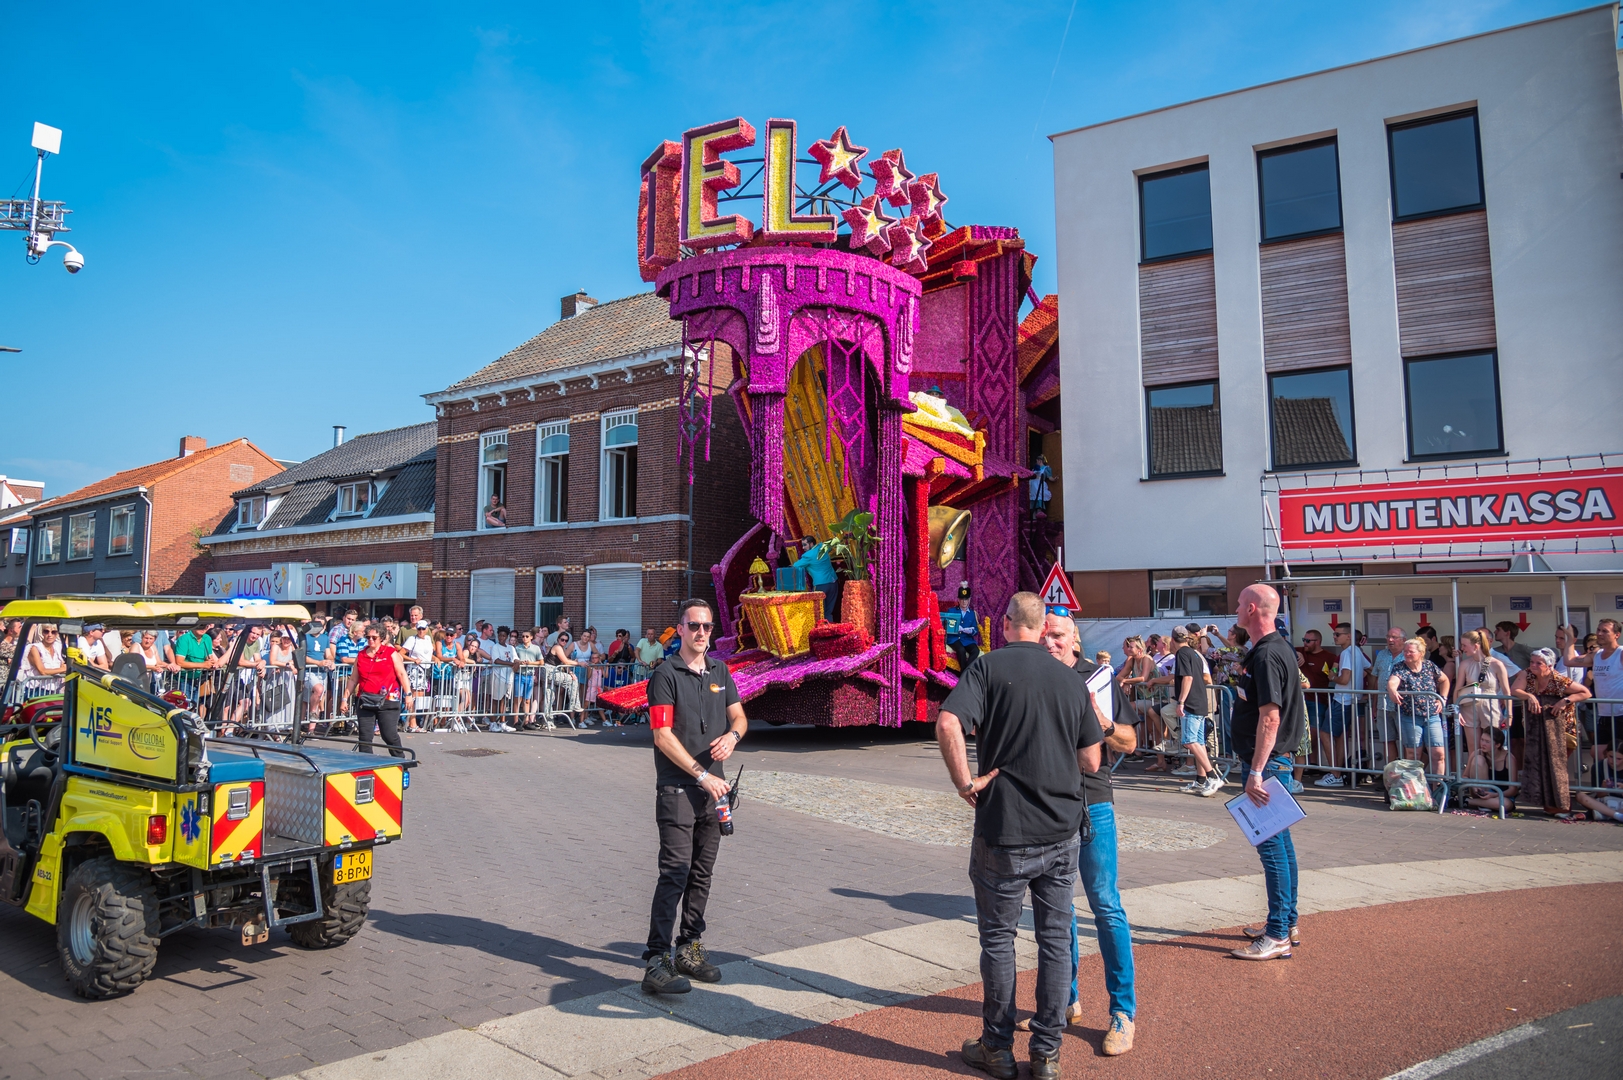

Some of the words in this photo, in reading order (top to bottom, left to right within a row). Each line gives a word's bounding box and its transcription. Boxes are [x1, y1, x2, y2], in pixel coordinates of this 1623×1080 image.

[1304, 487, 1614, 533] MUNTENKASSA
[237, 577, 272, 597] LUCKY
[315, 573, 356, 595] SUSHI
[144, 732, 165, 746] GLOBAL
[37, 868, 52, 881] AES-22
[336, 866, 369, 881] 8-BPN
